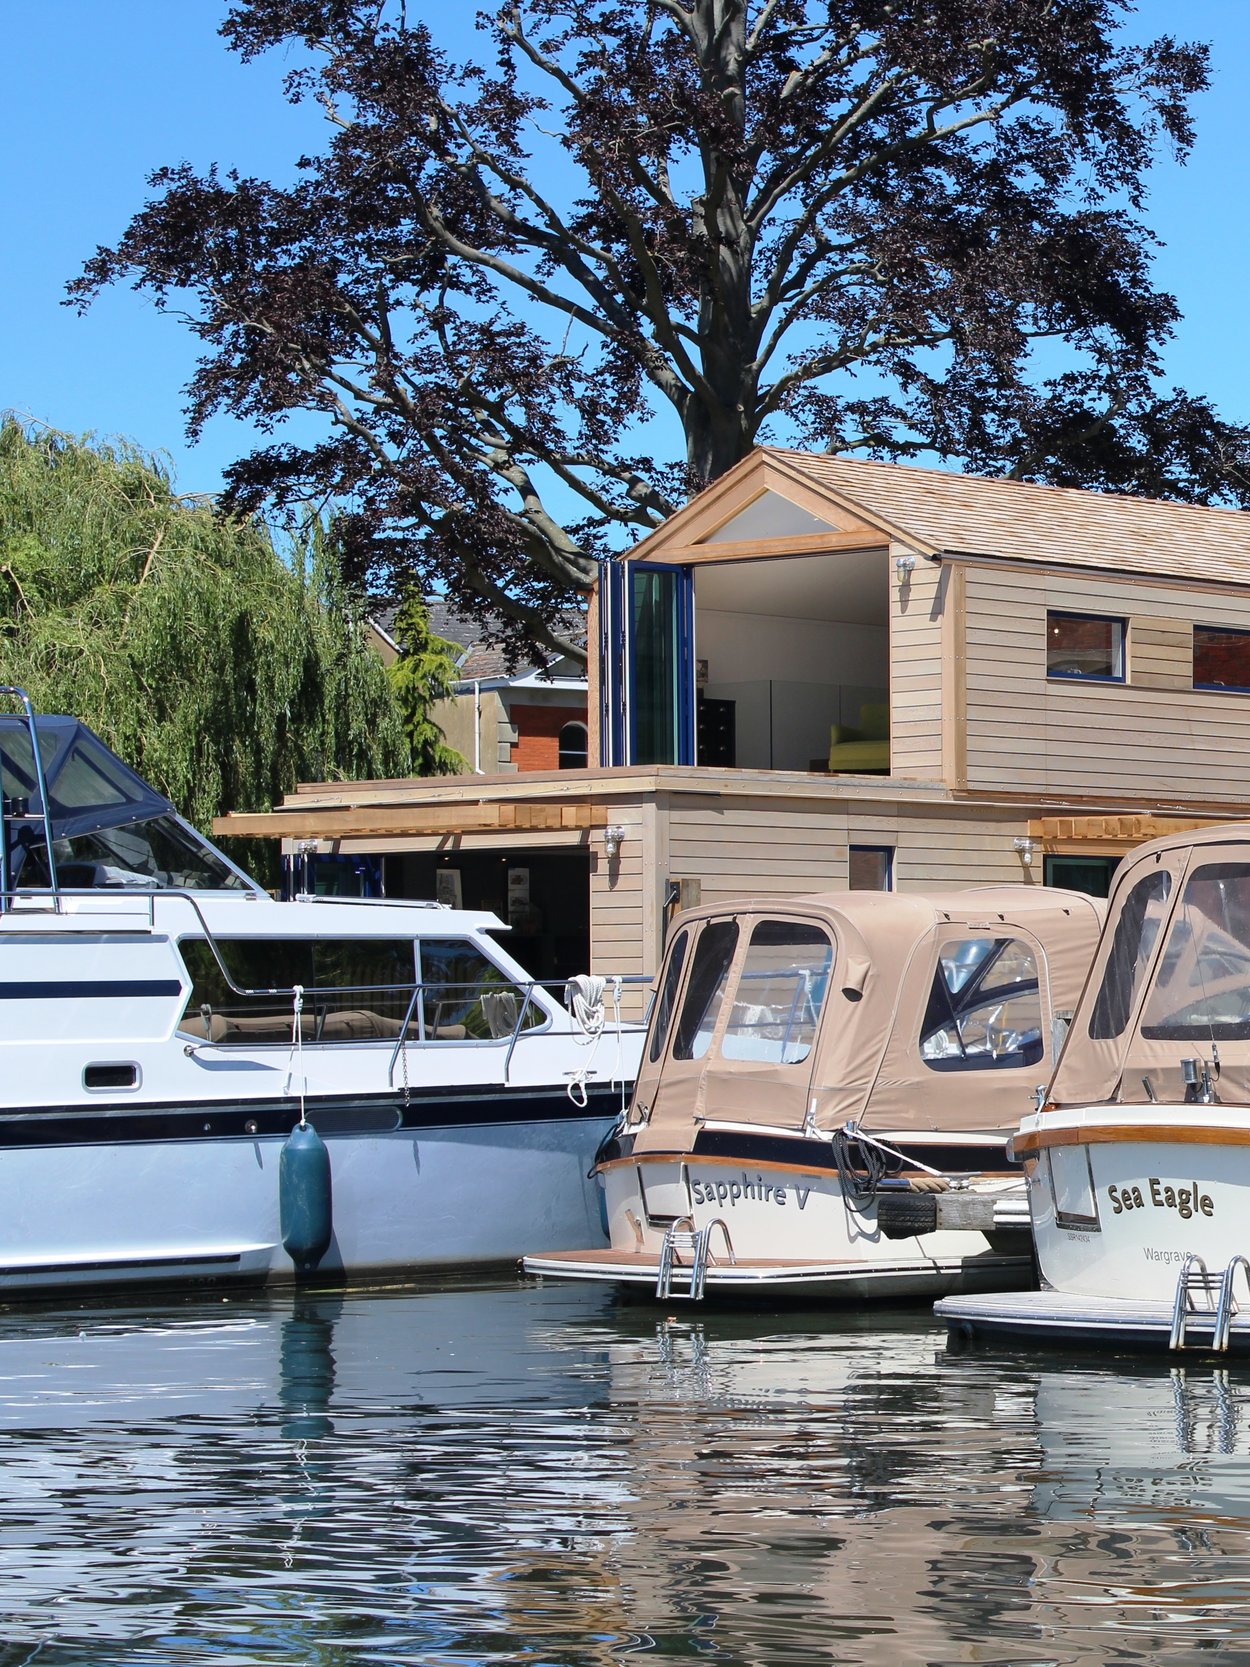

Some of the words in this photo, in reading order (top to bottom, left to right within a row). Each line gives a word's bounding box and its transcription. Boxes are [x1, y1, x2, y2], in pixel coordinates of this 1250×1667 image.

[691, 1171, 787, 1208] Sapphire
[795, 1184, 811, 1210] V
[1108, 1184, 1145, 1214] Sea
[1148, 1178, 1214, 1219] Eagle
